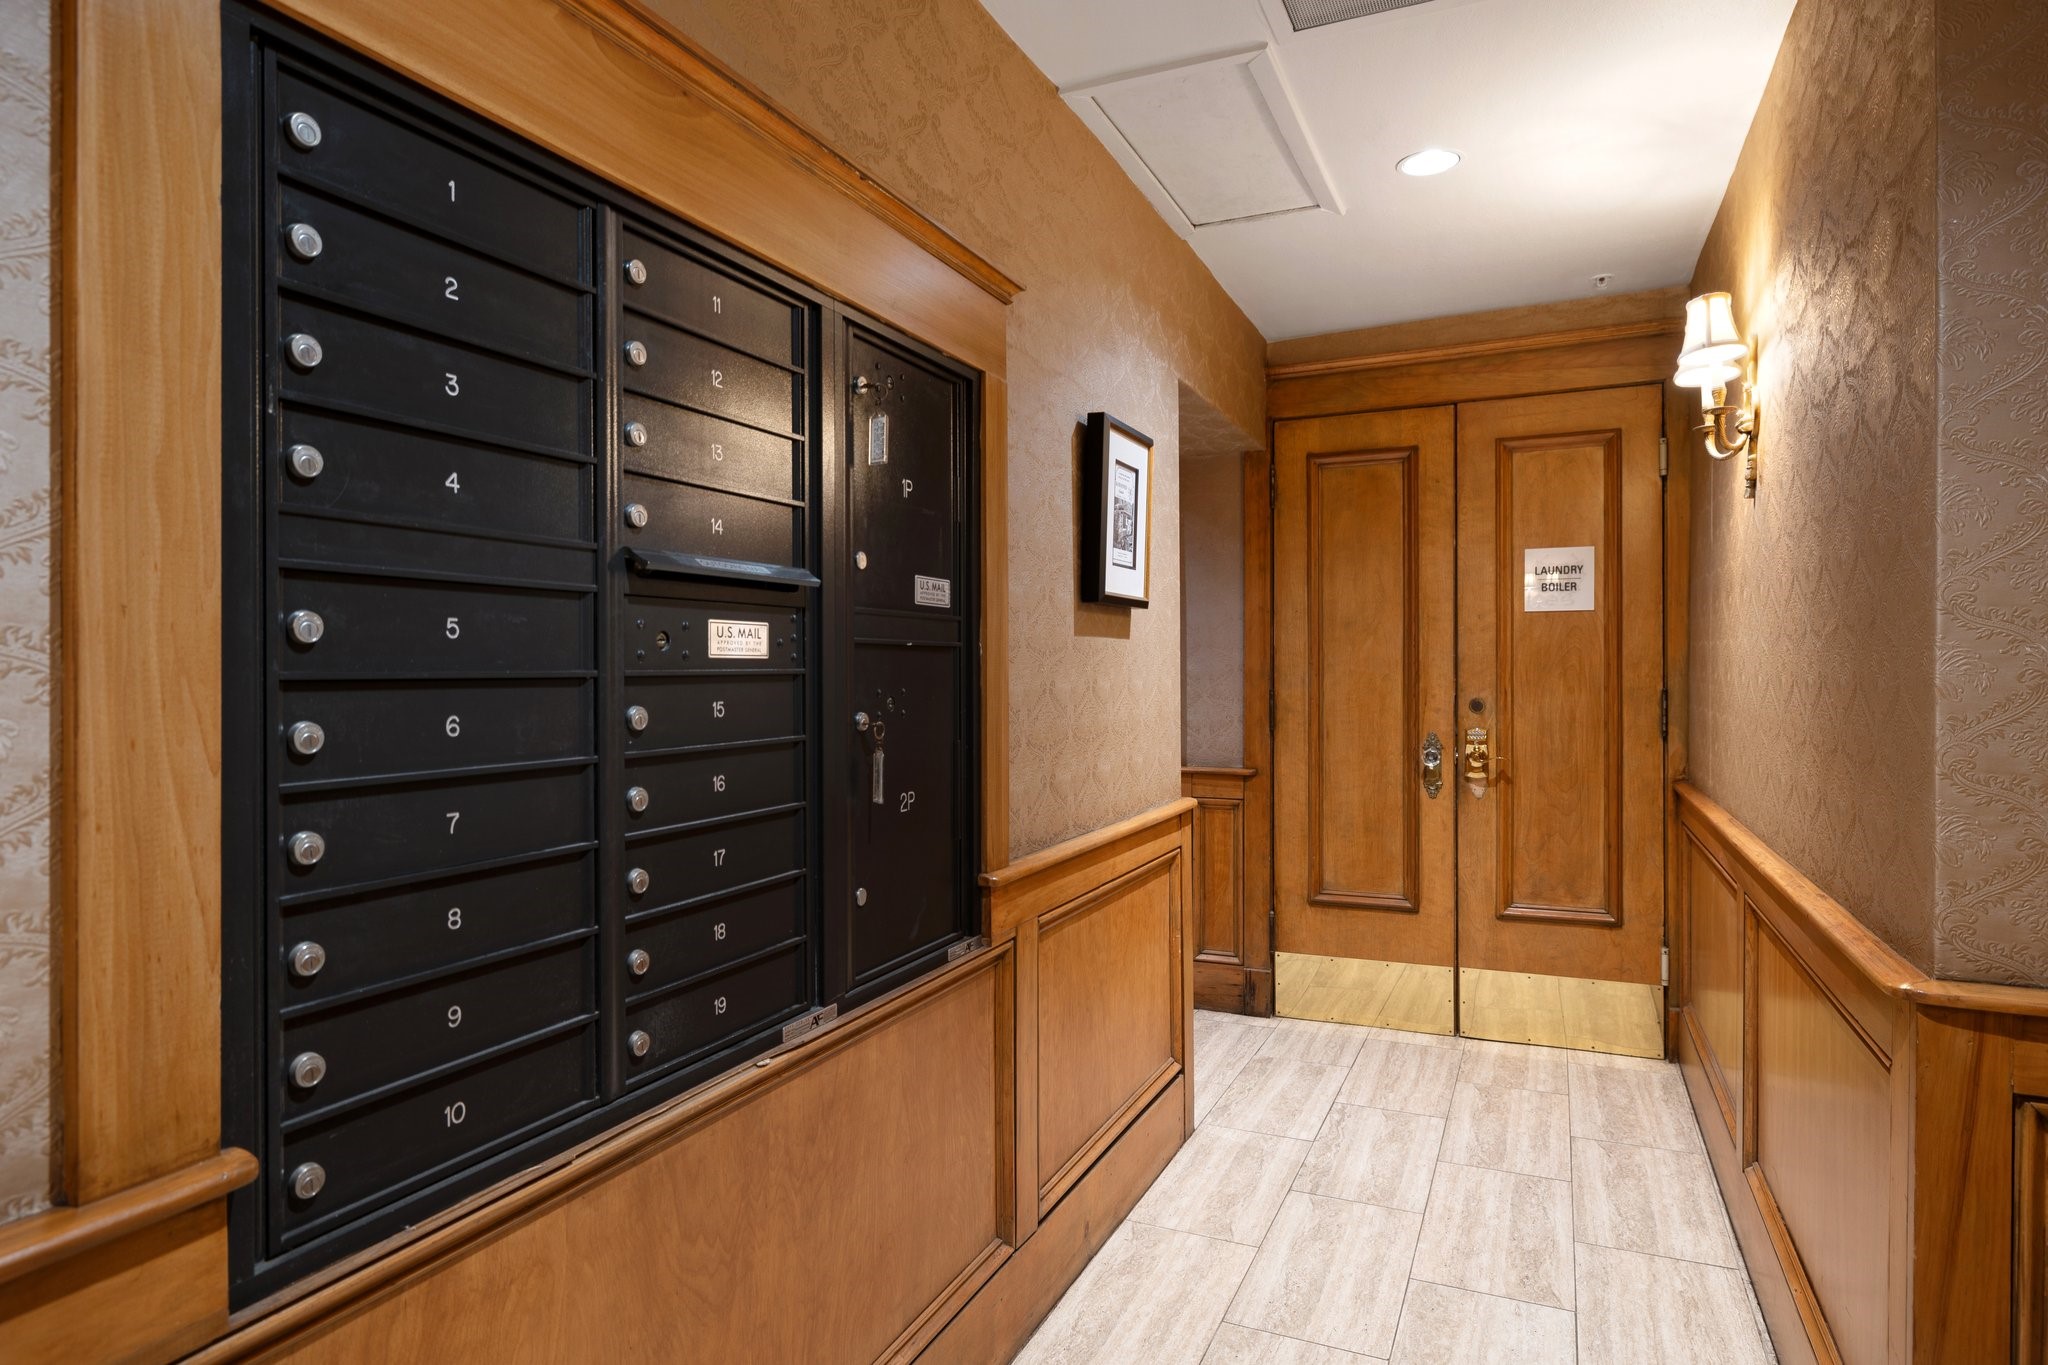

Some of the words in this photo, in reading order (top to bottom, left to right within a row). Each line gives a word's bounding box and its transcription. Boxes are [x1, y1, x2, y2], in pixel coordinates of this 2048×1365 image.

[447, 179, 457, 203] 1
[444, 275, 459, 301] 2
[711, 295, 722, 314] 11
[444, 372, 460, 397] 3
[710, 369, 723, 390] 12
[710, 444, 723, 462] 13
[445, 471, 460, 495] 4
[901, 478, 913, 498] 1P
[710, 517, 724, 535] 14
[1534, 565, 1584, 576] LAUNDRY
[931, 582, 946, 593] MAIL
[1541, 582, 1577, 592] BOILER
[445, 617, 460, 639] 5
[716, 626, 736, 638] U.S.
[737, 628, 762, 639] MAIL
[711, 700, 725, 718] 15
[445, 715, 460, 738] 6
[712, 774, 726, 792] 16
[900, 791, 916, 813] 2P
[446, 811, 460, 835] 7
[713, 848, 726, 867] 17
[447, 907, 461, 931] 8
[713, 922, 727, 941] 18
[713, 996, 727, 1015] 19
[447, 1005, 462, 1028] 9
[444, 1100, 466, 1128] 10
